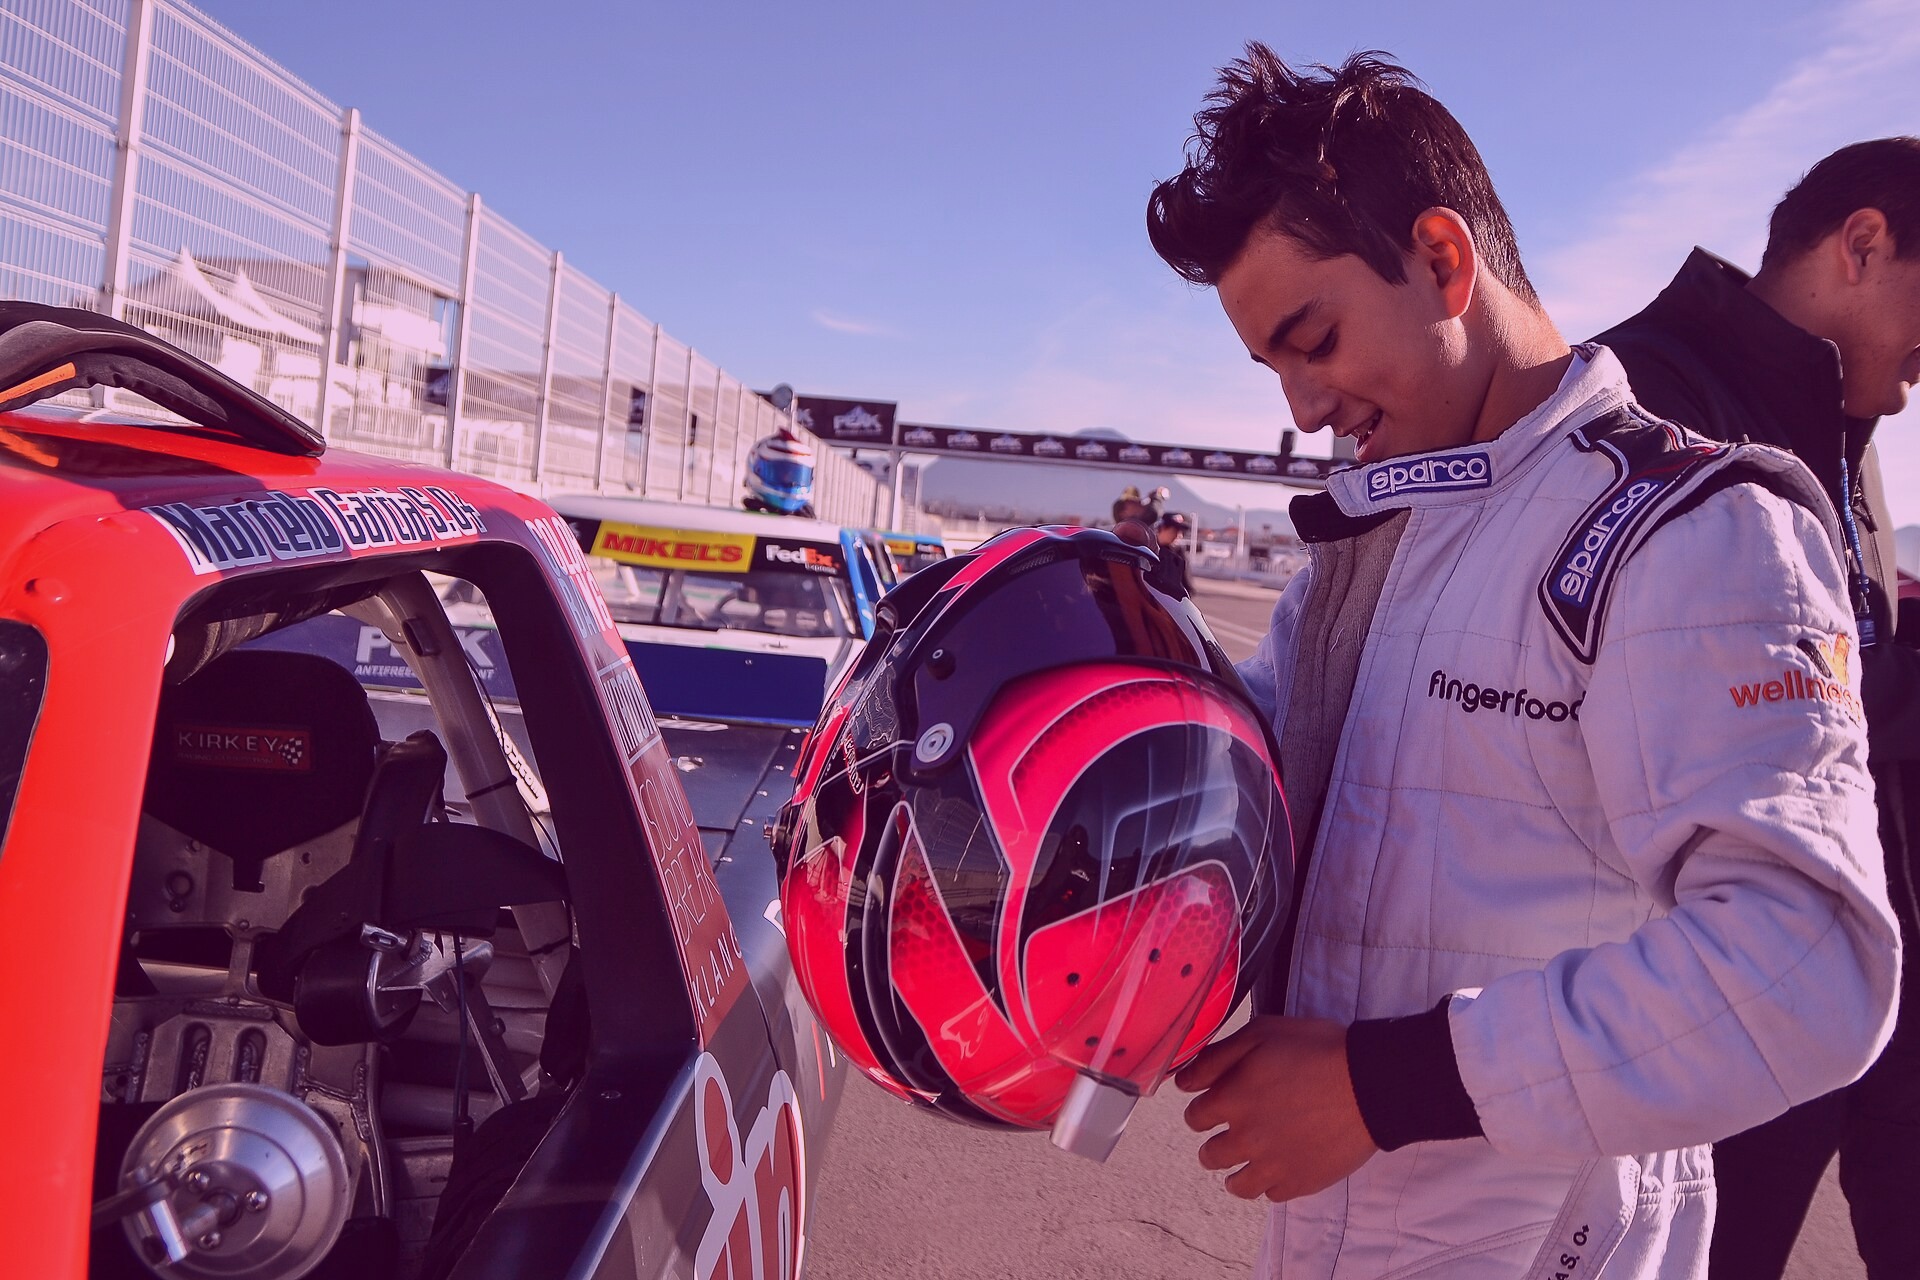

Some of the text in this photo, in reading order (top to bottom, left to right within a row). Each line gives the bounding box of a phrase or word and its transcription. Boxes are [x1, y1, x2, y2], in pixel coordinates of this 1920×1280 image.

[1371, 457, 1487, 493] sparco
[765, 544, 835, 568] FedEx
[1560, 482, 1652, 597] sparco
[178, 732, 278, 752] KIRKEY
[664, 837, 721, 945] BREAK
